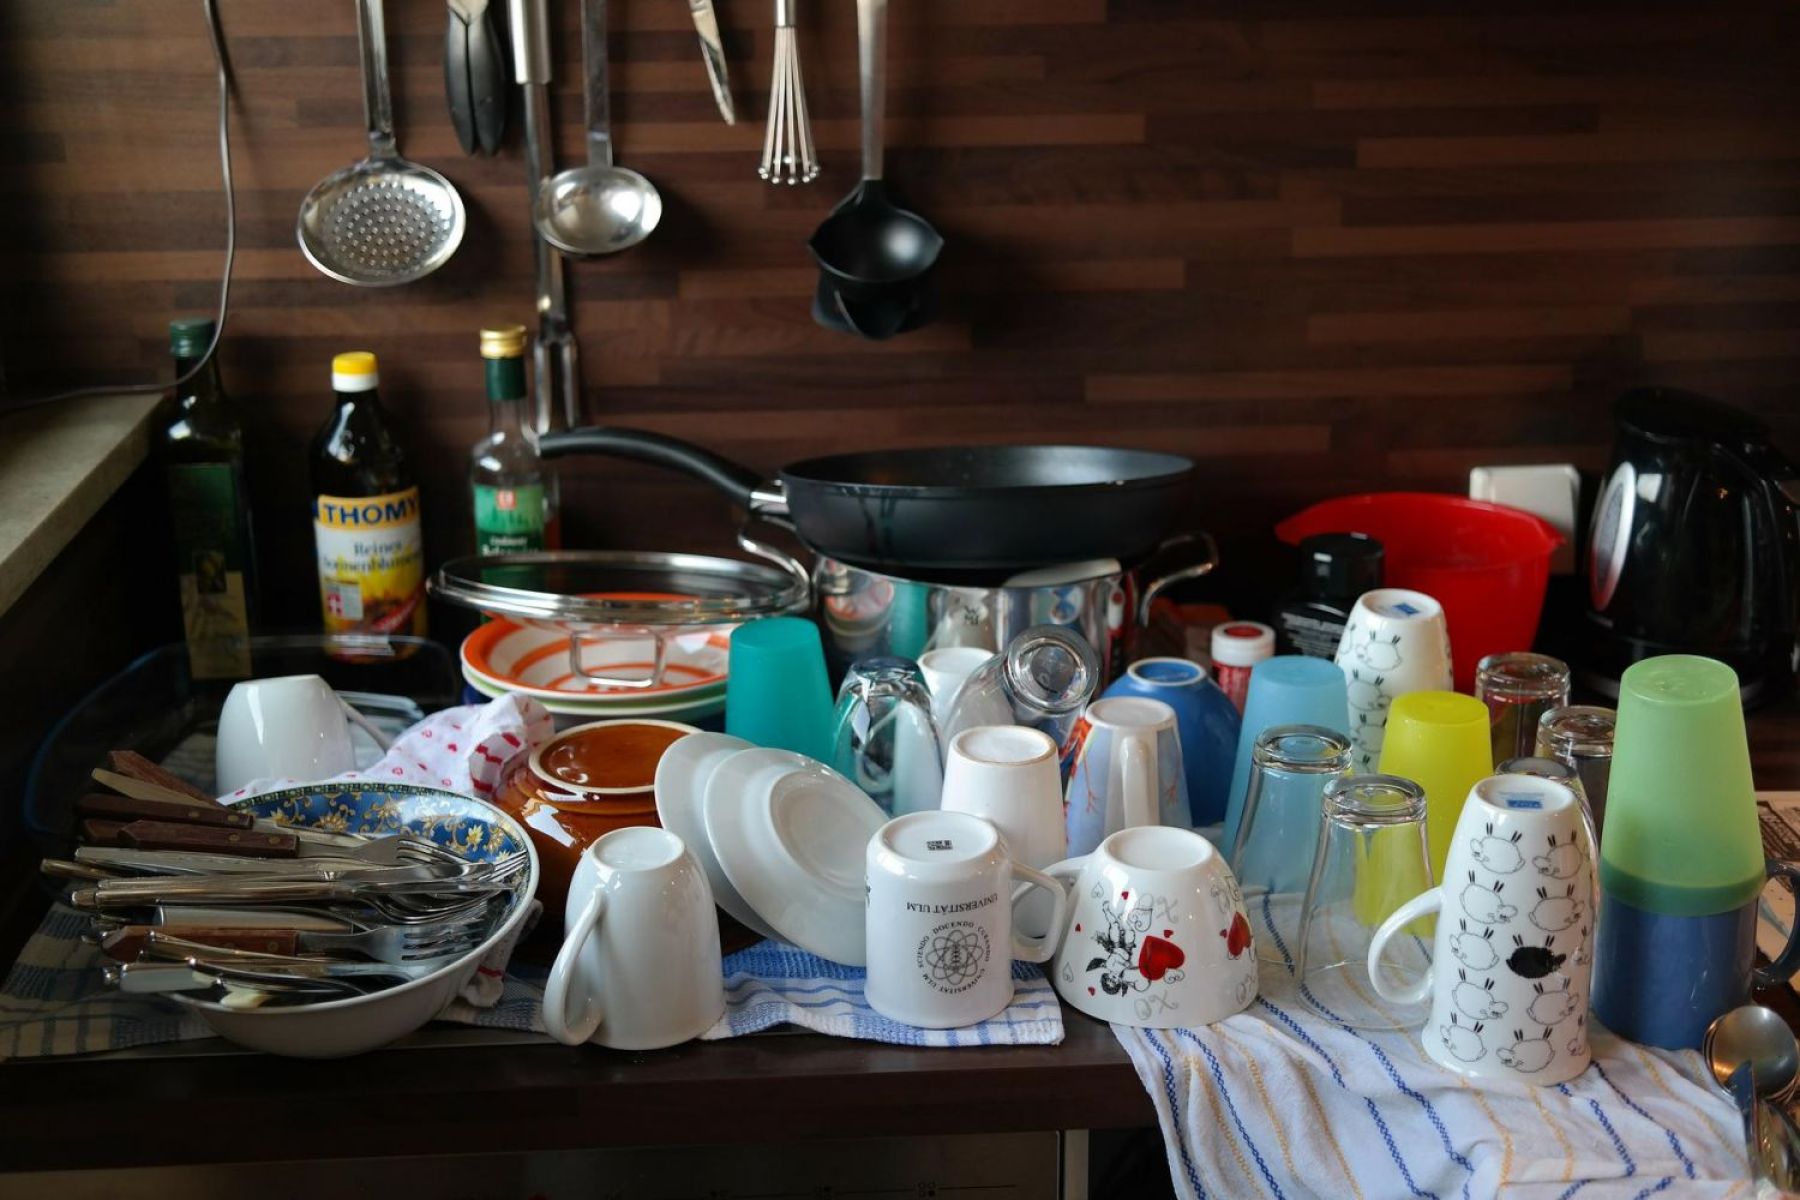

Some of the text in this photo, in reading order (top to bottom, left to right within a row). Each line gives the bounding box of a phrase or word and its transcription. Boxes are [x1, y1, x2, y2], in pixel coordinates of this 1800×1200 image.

[324, 498, 417, 525] THOMY
[906, 892, 998, 915] UNIVERSITÄT ULM
